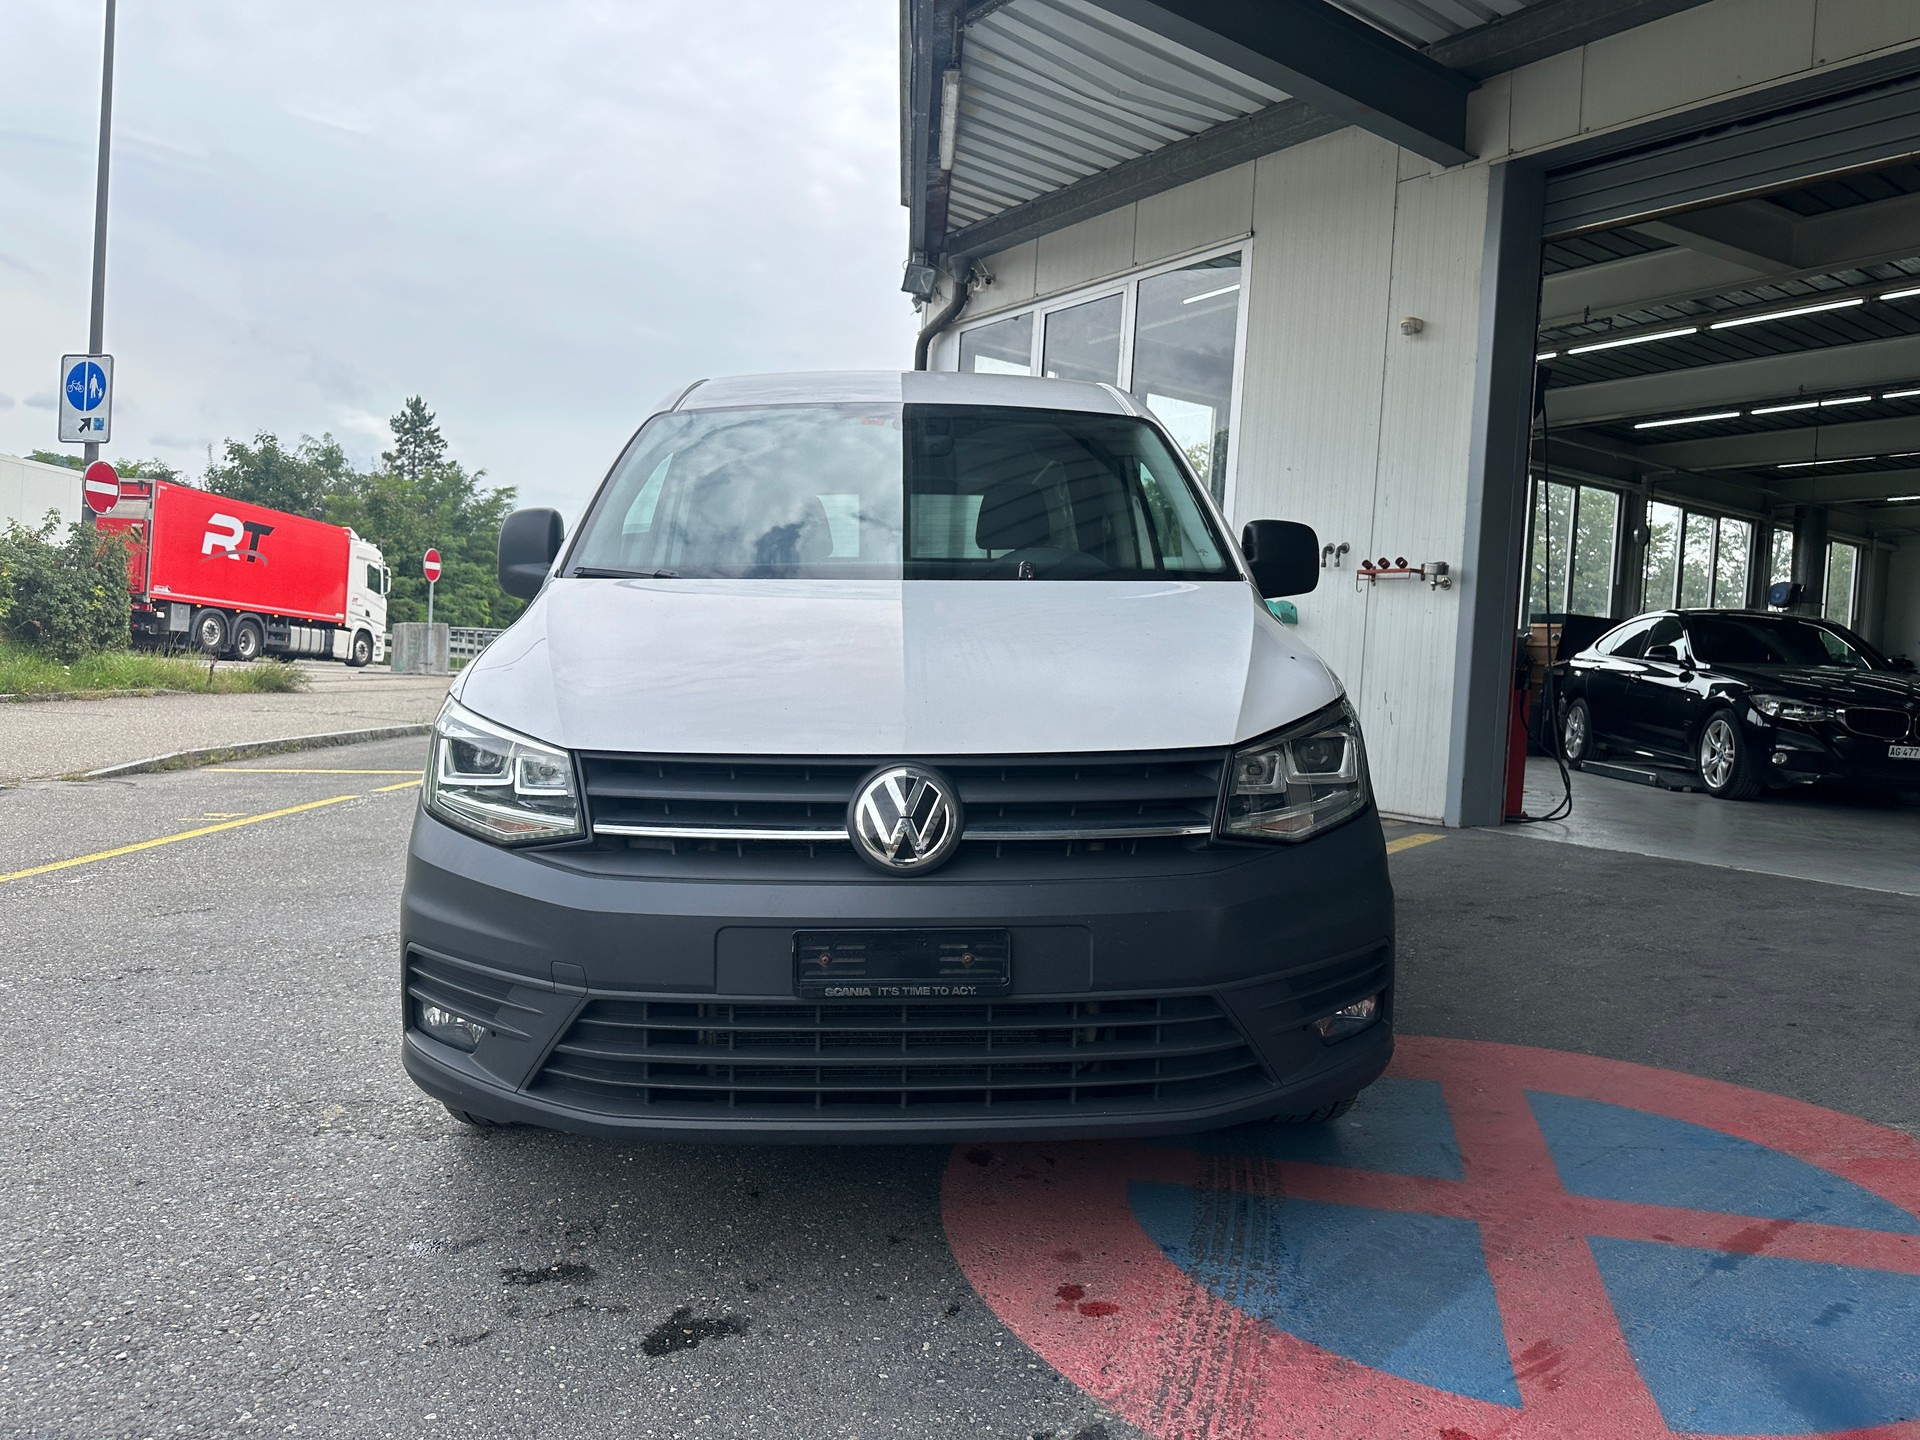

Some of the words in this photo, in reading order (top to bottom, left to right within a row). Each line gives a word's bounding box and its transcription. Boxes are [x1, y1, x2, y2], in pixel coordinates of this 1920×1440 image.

[201, 512, 275, 563] RT
[1889, 746, 1901, 756] AG
[824, 987, 871, 997] SCANIA
[878, 986, 900, 996] IT'S
[901, 986, 931, 996] TIME
[932, 986, 950, 996] TO
